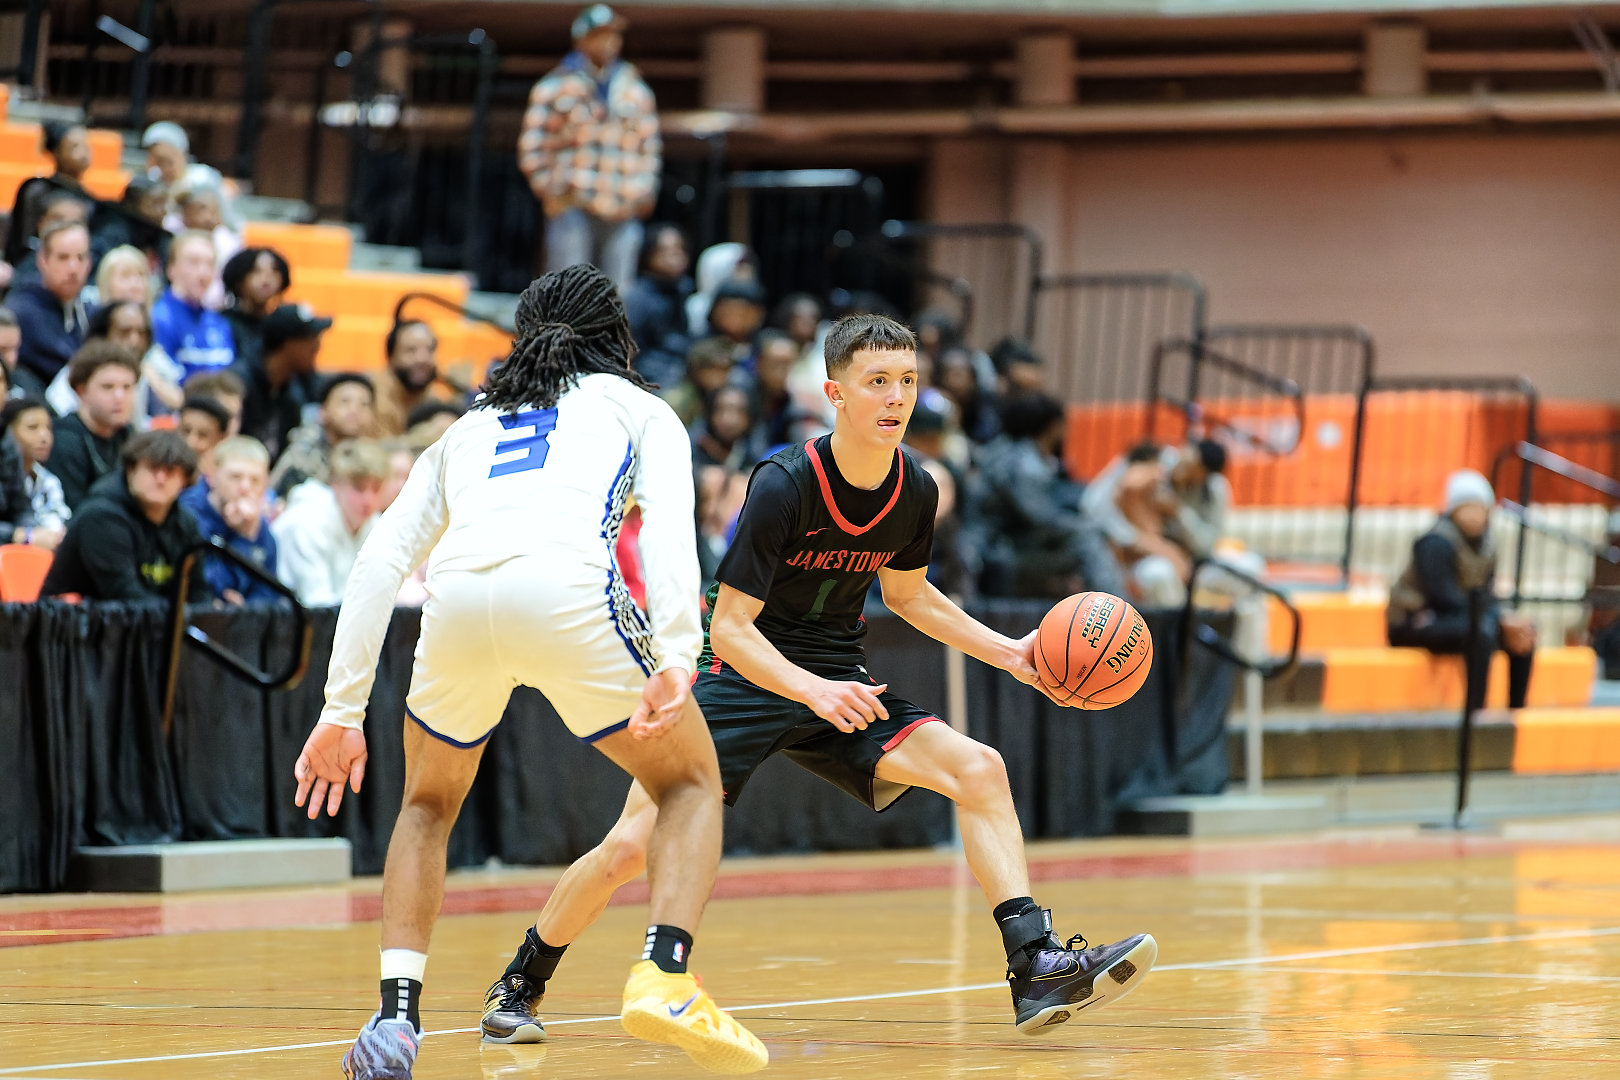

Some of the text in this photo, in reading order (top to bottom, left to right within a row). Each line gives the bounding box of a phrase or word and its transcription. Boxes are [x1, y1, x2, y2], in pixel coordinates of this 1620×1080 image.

[488, 406, 558, 478] 3
[801, 578, 838, 621] 1
[1088, 597, 1118, 648] LEGACY
